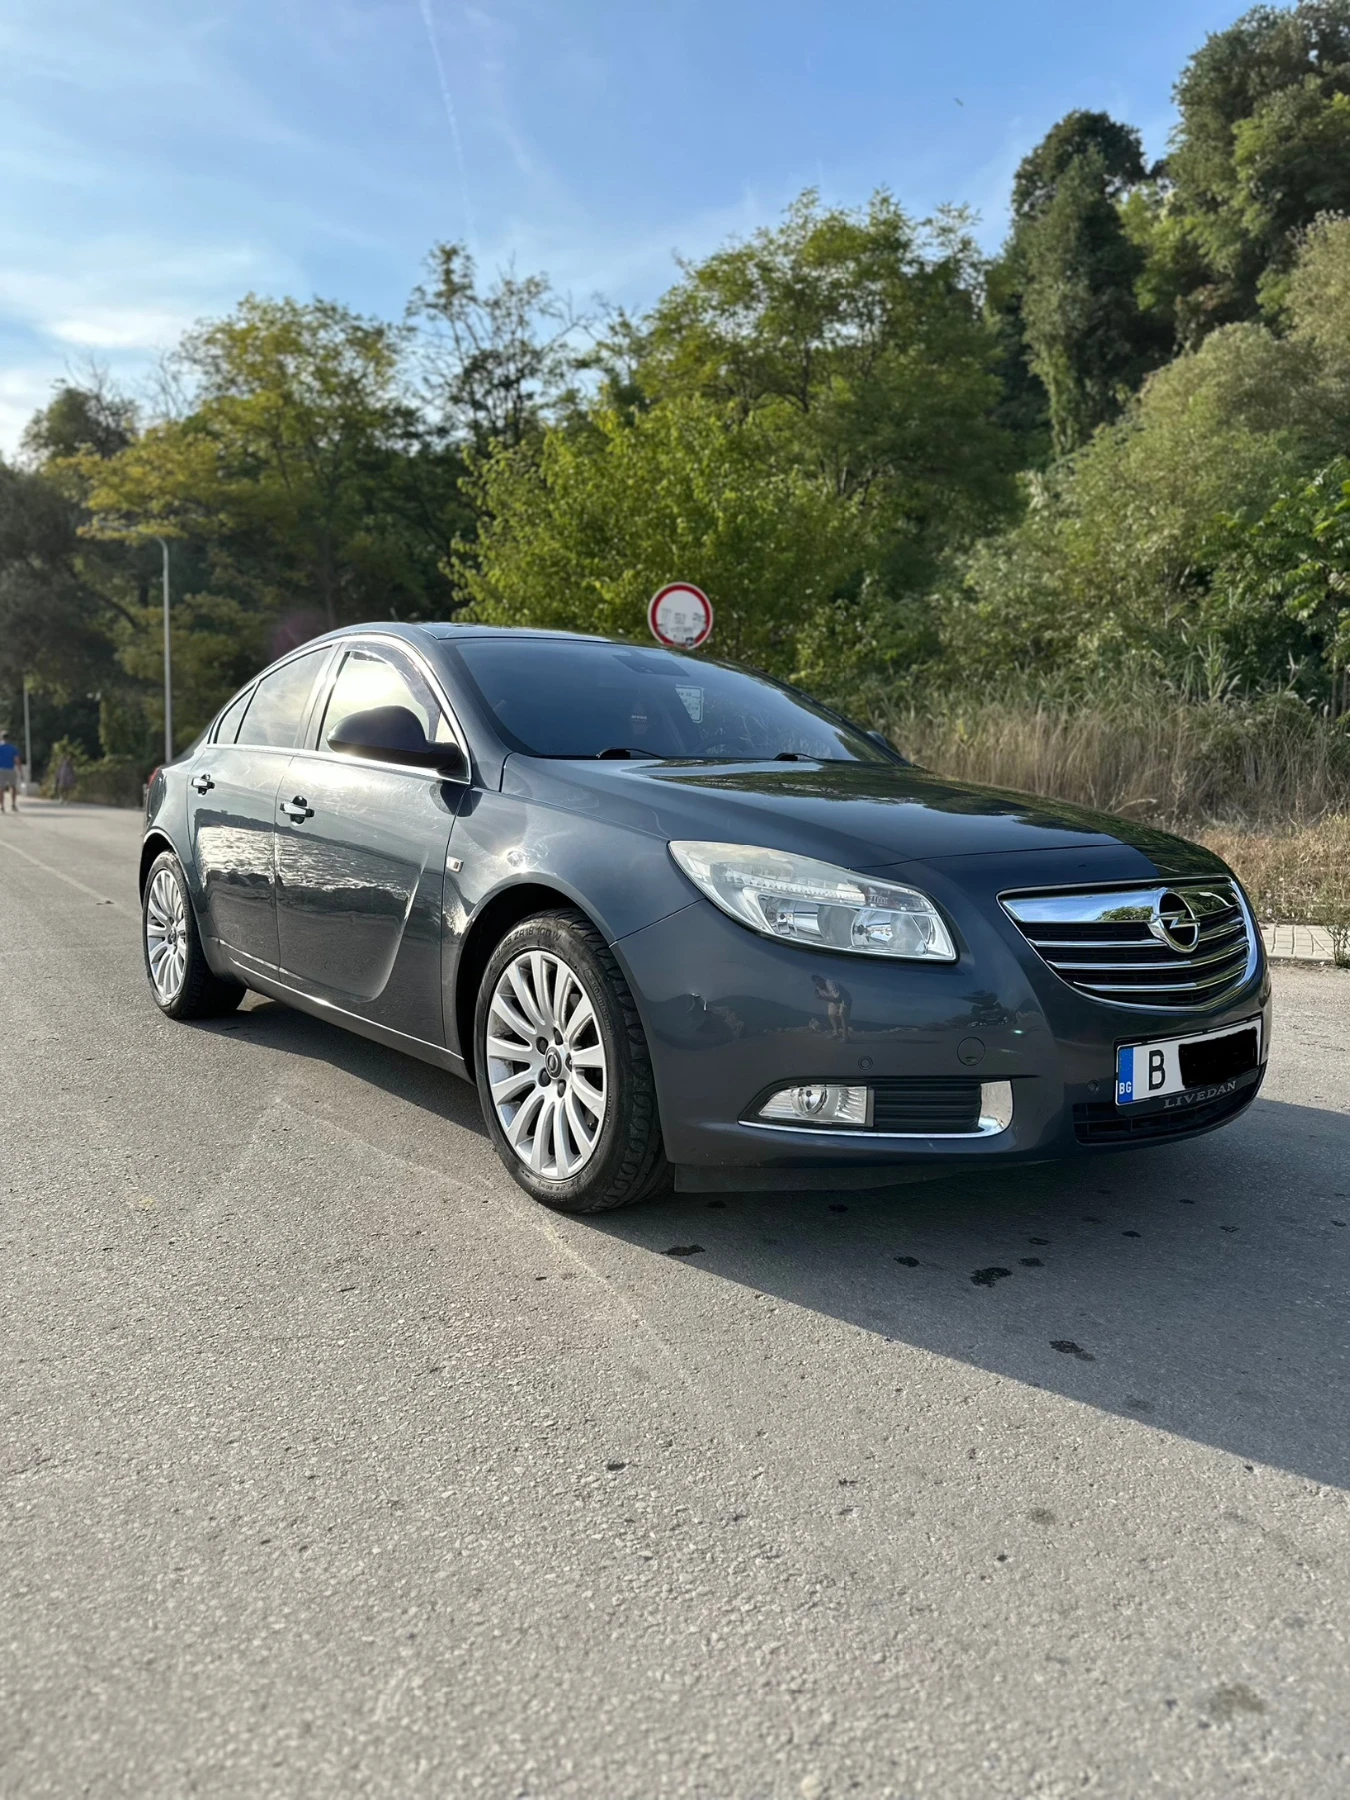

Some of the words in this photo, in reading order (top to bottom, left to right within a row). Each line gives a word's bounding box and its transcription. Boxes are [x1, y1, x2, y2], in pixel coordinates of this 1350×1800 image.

[1149, 1049, 1166, 1091] B
[1119, 1081, 1132, 1095] BG
[1164, 1080, 1237, 1109] LIVEDAN
